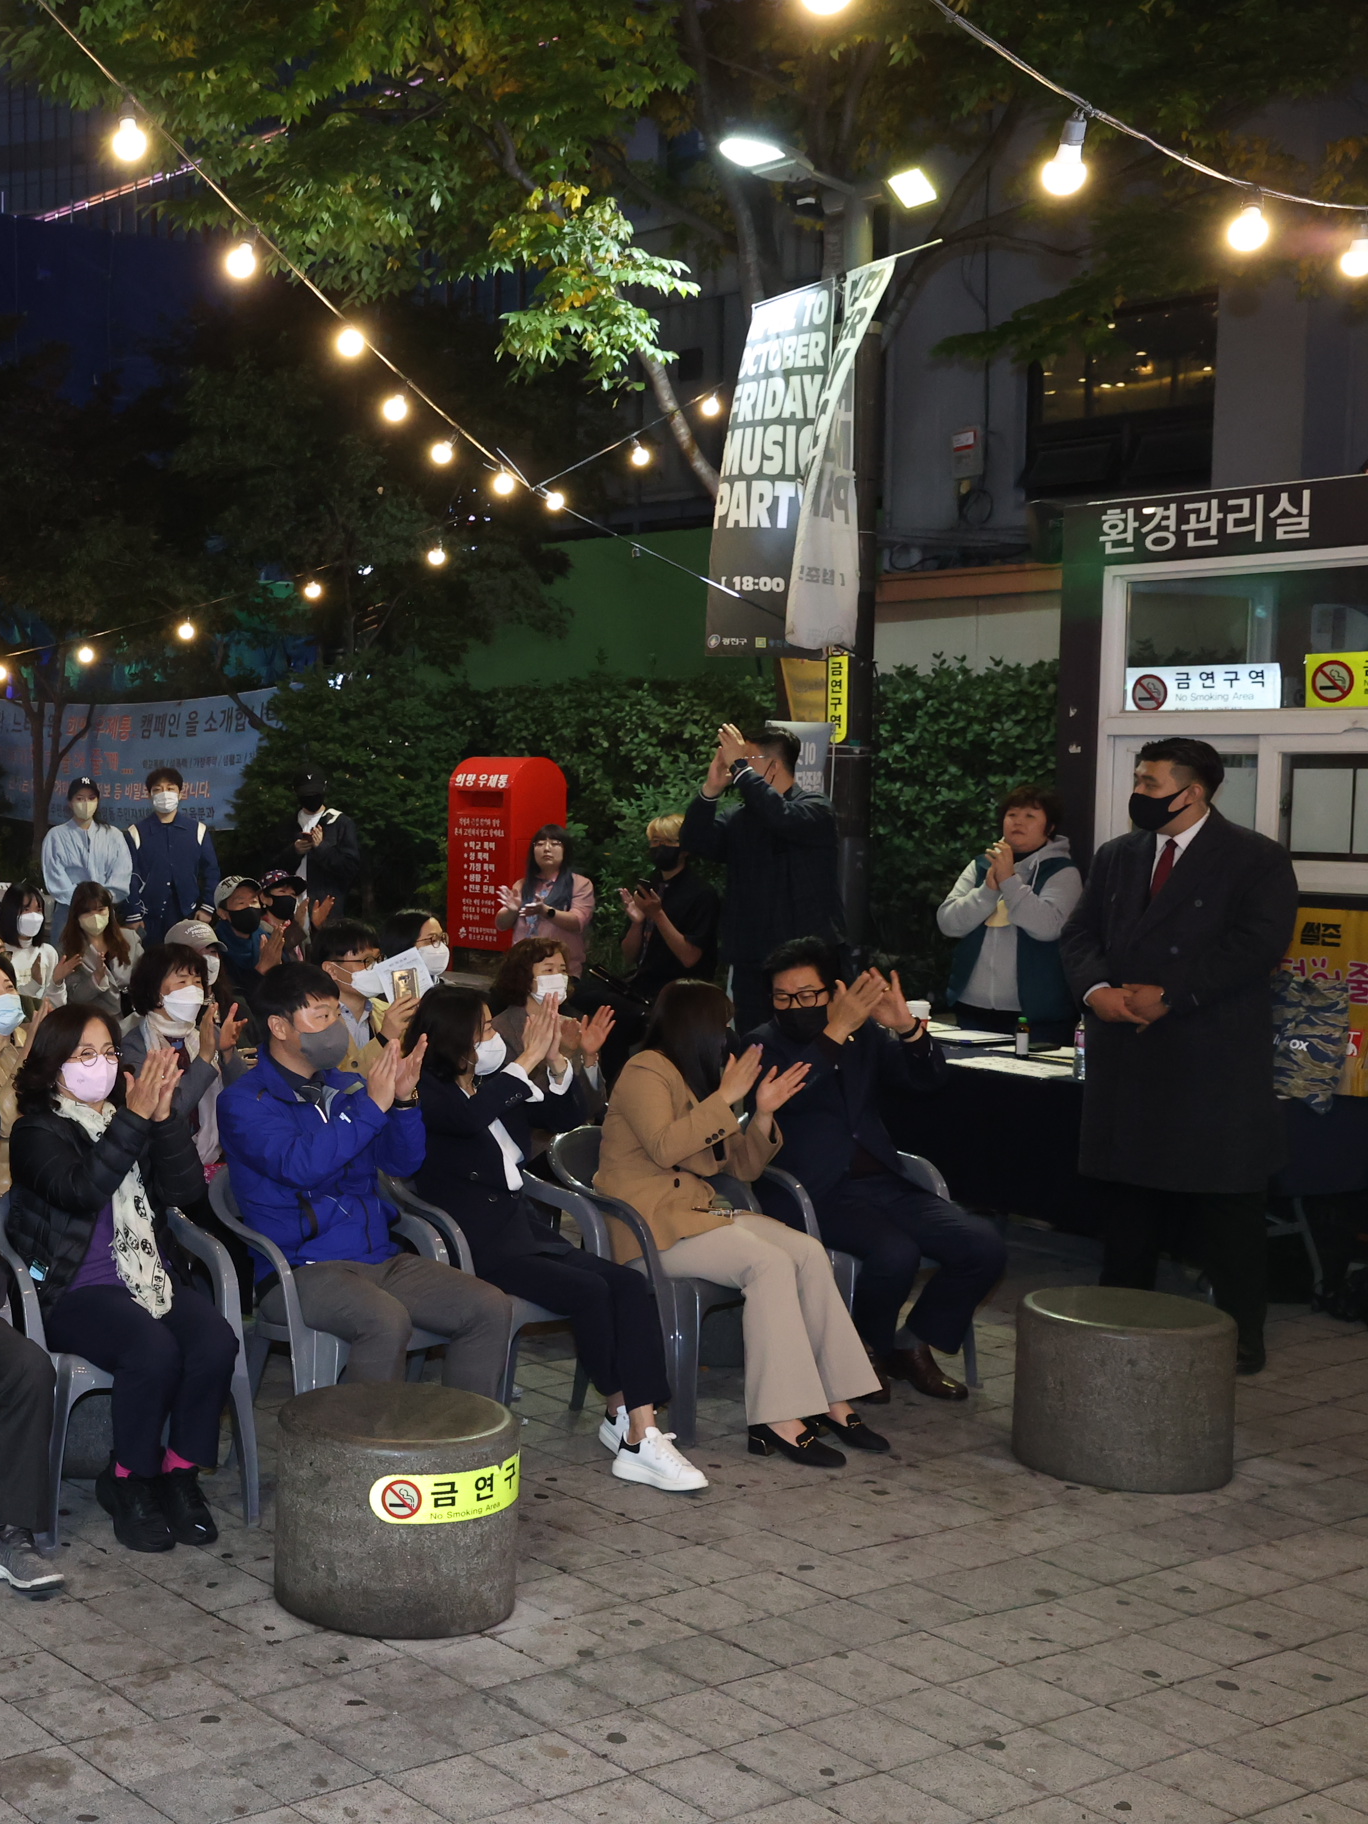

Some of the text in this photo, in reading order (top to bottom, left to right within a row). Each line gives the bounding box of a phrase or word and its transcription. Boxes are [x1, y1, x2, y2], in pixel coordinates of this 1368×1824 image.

[802, 289, 830, 327] TO
[738, 331, 826, 379] OCTOBER
[729, 374, 824, 425] FRIDAY
[1098, 489, 1312, 555] 환경관리실
[732, 575, 786, 592] 18:00
[1175, 670, 1265, 689] 금연구역
[1175, 691, 1255, 703] No Smoking Area
[455, 773, 476, 787] 희망
[430, 1501, 501, 1520] No Smoking Area
